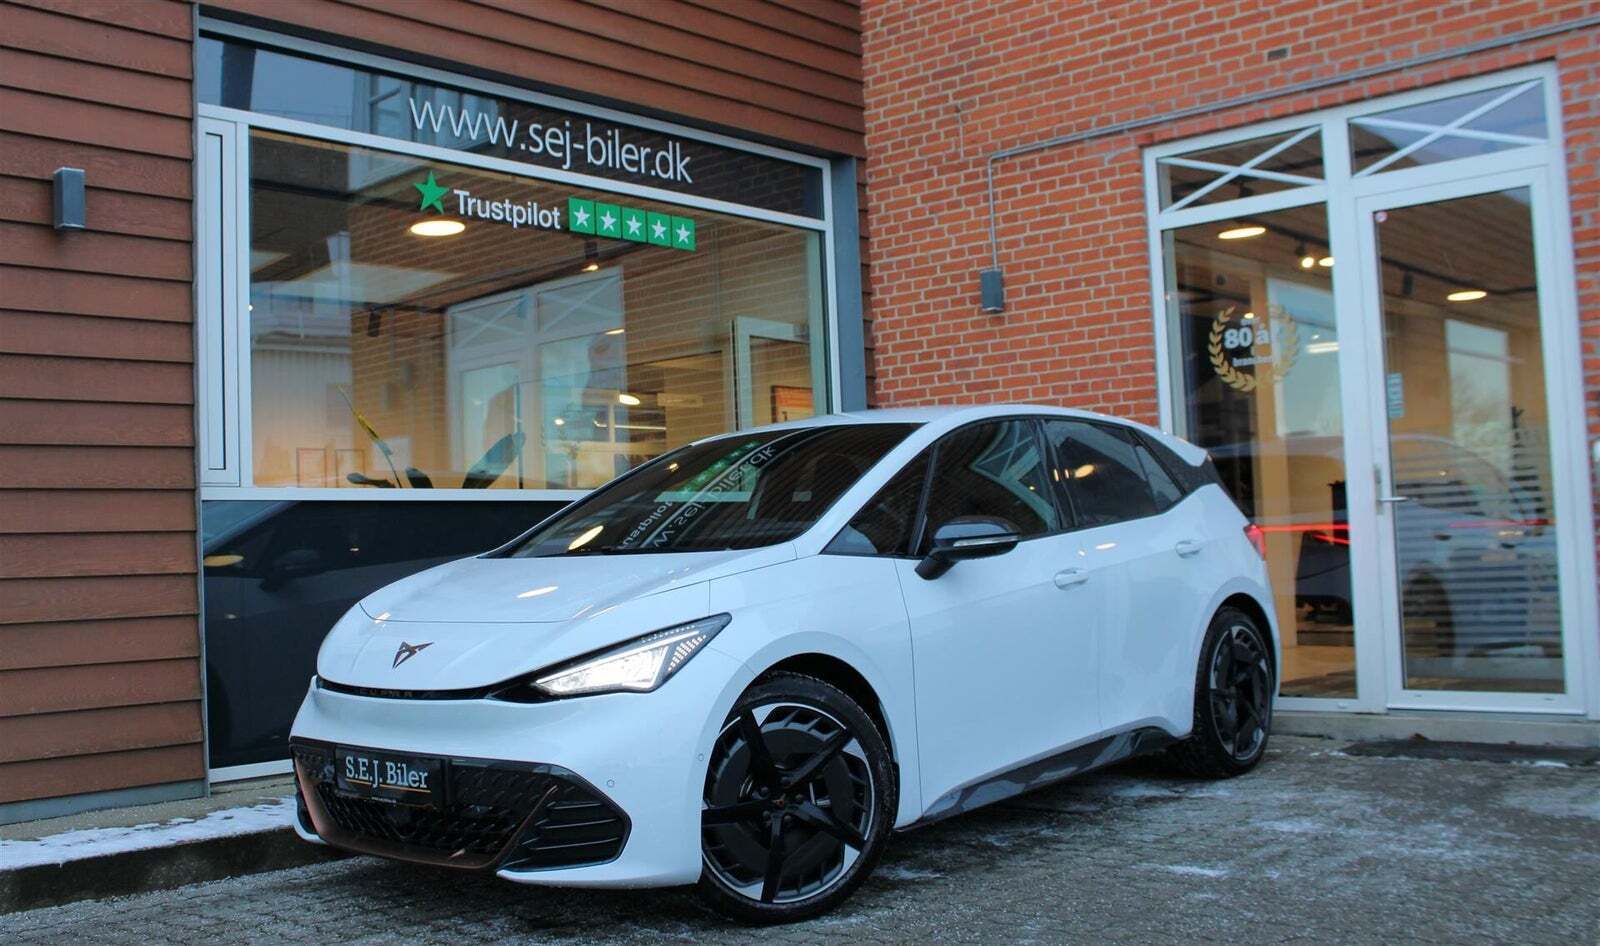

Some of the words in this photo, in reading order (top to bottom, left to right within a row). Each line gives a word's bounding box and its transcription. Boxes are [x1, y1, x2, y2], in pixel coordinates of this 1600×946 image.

[409, 98, 693, 184] www.sej-biler.dk
[453, 189, 561, 230] Trustpilot
[1223, 327, 1253, 349] 80
[345, 756, 383, 788] S.E.J.
[385, 761, 429, 788] Biler
